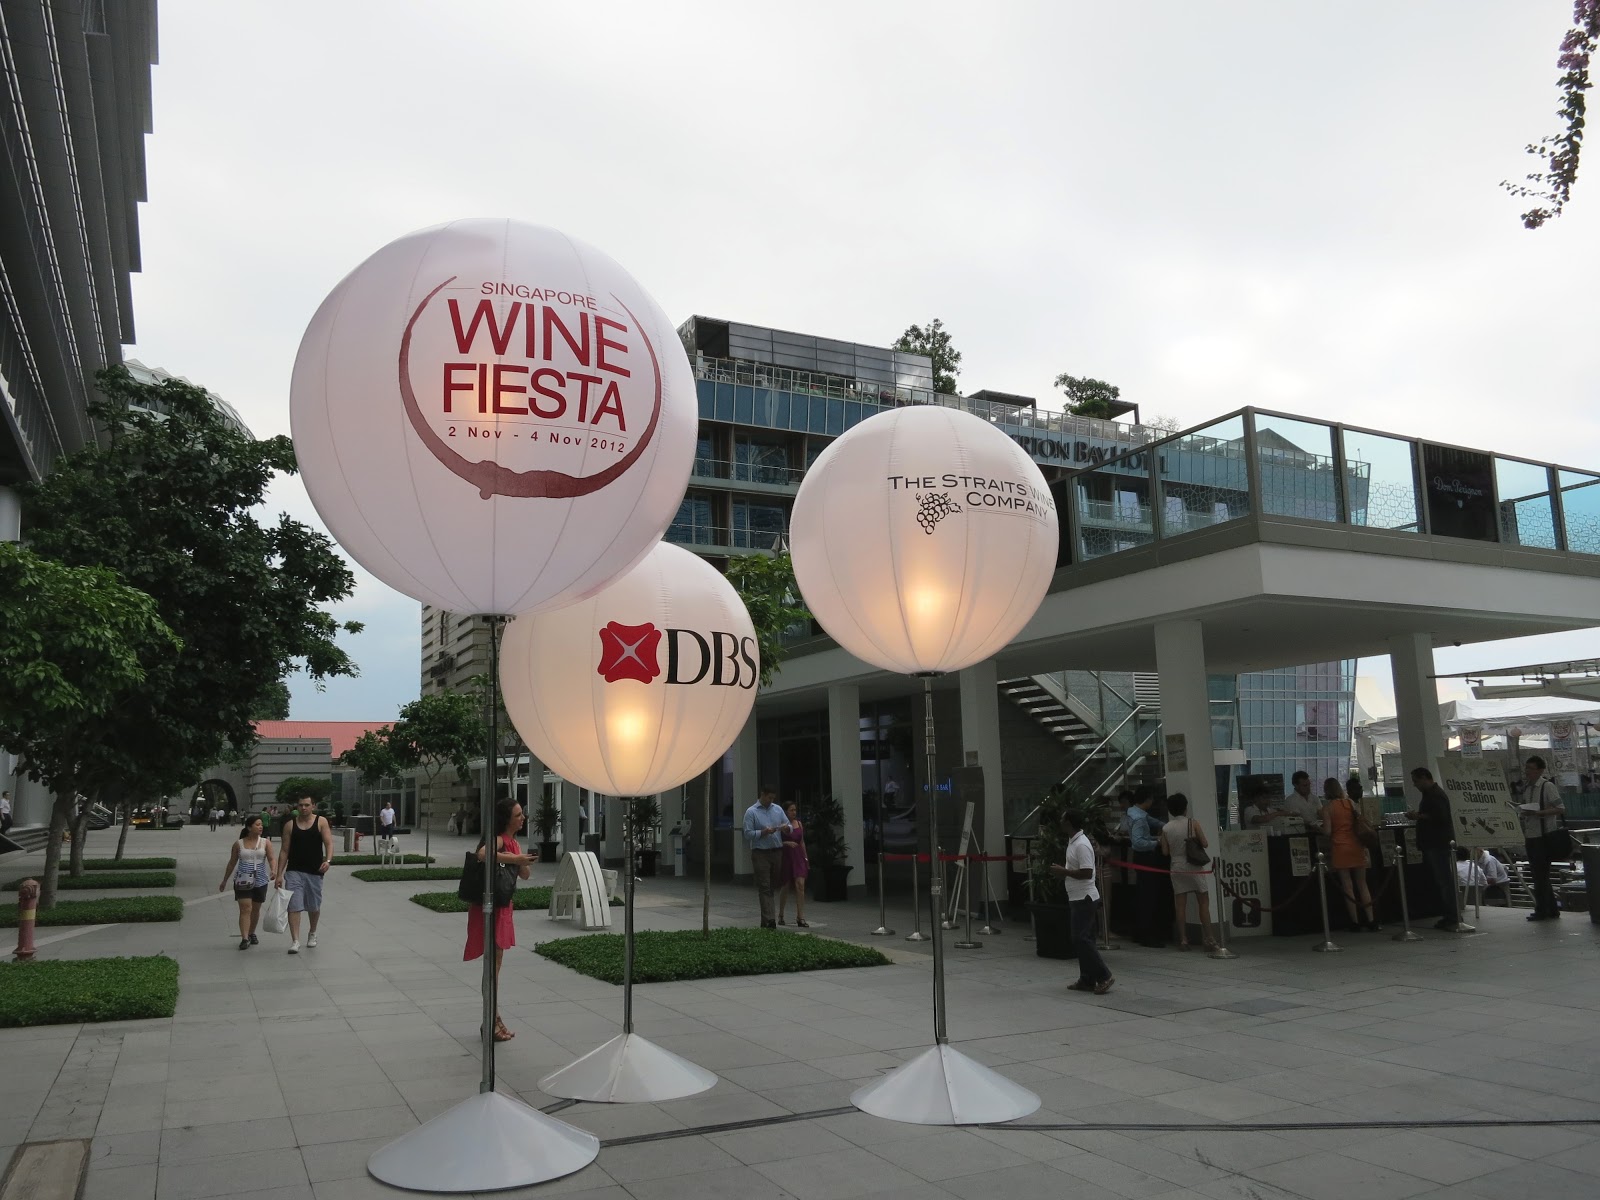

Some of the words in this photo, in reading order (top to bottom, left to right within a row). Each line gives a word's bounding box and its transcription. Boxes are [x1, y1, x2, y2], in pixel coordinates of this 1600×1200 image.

[480, 281, 598, 311] SINGAPORE
[447, 298, 631, 378] WINE
[443, 362, 626, 432] FIESTA
[448, 426, 457, 437] 2
[468, 426, 502, 439] Nov
[530, 431, 539, 441] 4
[549, 432, 582, 446] Nov
[590, 438, 625, 453] 2012
[1073, 441, 1109, 464] BAY
[887, 475, 937, 490] THE
[942, 474, 1027, 496] STRAITS
[1029, 485, 1056, 511] WINE
[1433, 475, 1452, 492] Dom
[966, 491, 1048, 521] COMPANY
[664, 628, 757, 689] DBS
[1446, 779, 1473, 792] Glass
[1475, 780, 1506, 792] Return
[1462, 791, 1497, 804] Station
